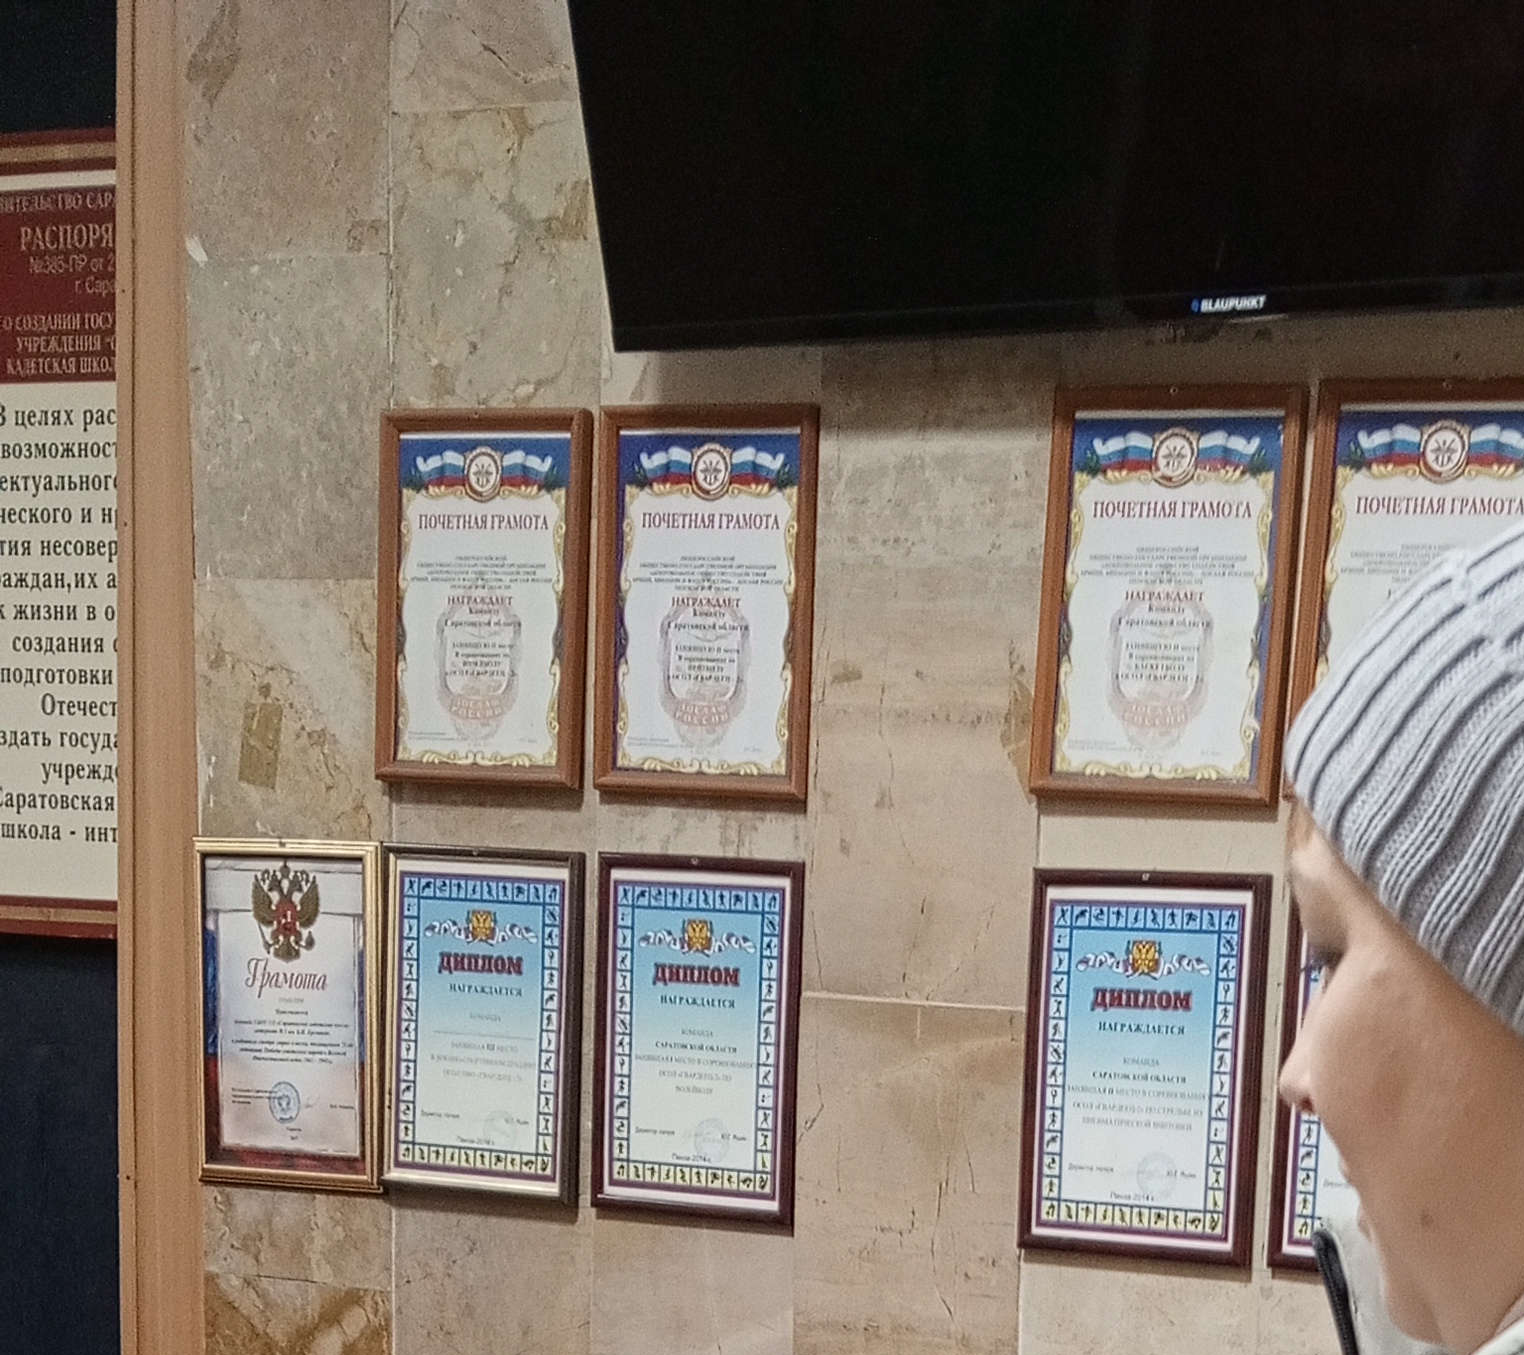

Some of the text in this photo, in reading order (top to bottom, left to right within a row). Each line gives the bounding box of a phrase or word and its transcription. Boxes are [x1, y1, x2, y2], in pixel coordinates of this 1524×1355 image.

[20, 222, 113, 251] РАСПОРЯ
[1201, 294, 1266, 313] BLAUPUNKT
[15, 313, 80, 332] СОЗДАНИИ
[16, 335, 100, 353] УЧРЕЖДЕНИЯ
[6, 356, 76, 377] КАДЕТСКАЯ
[14, 408, 74, 429] целях
[82, 408, 116, 432] рас
[1093, 501, 1252, 519] ПОЧЕТНАЯ ГРАМОТА
[1356, 496, 1524, 515] ПОЧЕТНАЯ ГРАМОТА
[81, 507, 92, 524] и
[418, 514, 549, 531] ПОЧЕТНАЯ ГРАМОТА
[641, 512, 780, 530] ПОЧЕТНАЯ ГРАМОТА
[13, 604, 77, 621] жизни
[86, 605, 96, 621] в
[12, 636, 104, 656] создания
[0, 667, 113, 687] подготовки
[1, 822, 61, 841] школа
[438, 951, 523, 976] ДИПЛОМ
[245, 957, 328, 999] Грамота
[652, 962, 740, 987] ДИПЛОМ
[1090, 987, 1192, 1012] ДИПЛОМ
[1098, 1021, 1185, 1035] НАГРАЖДАЕТСЯ
